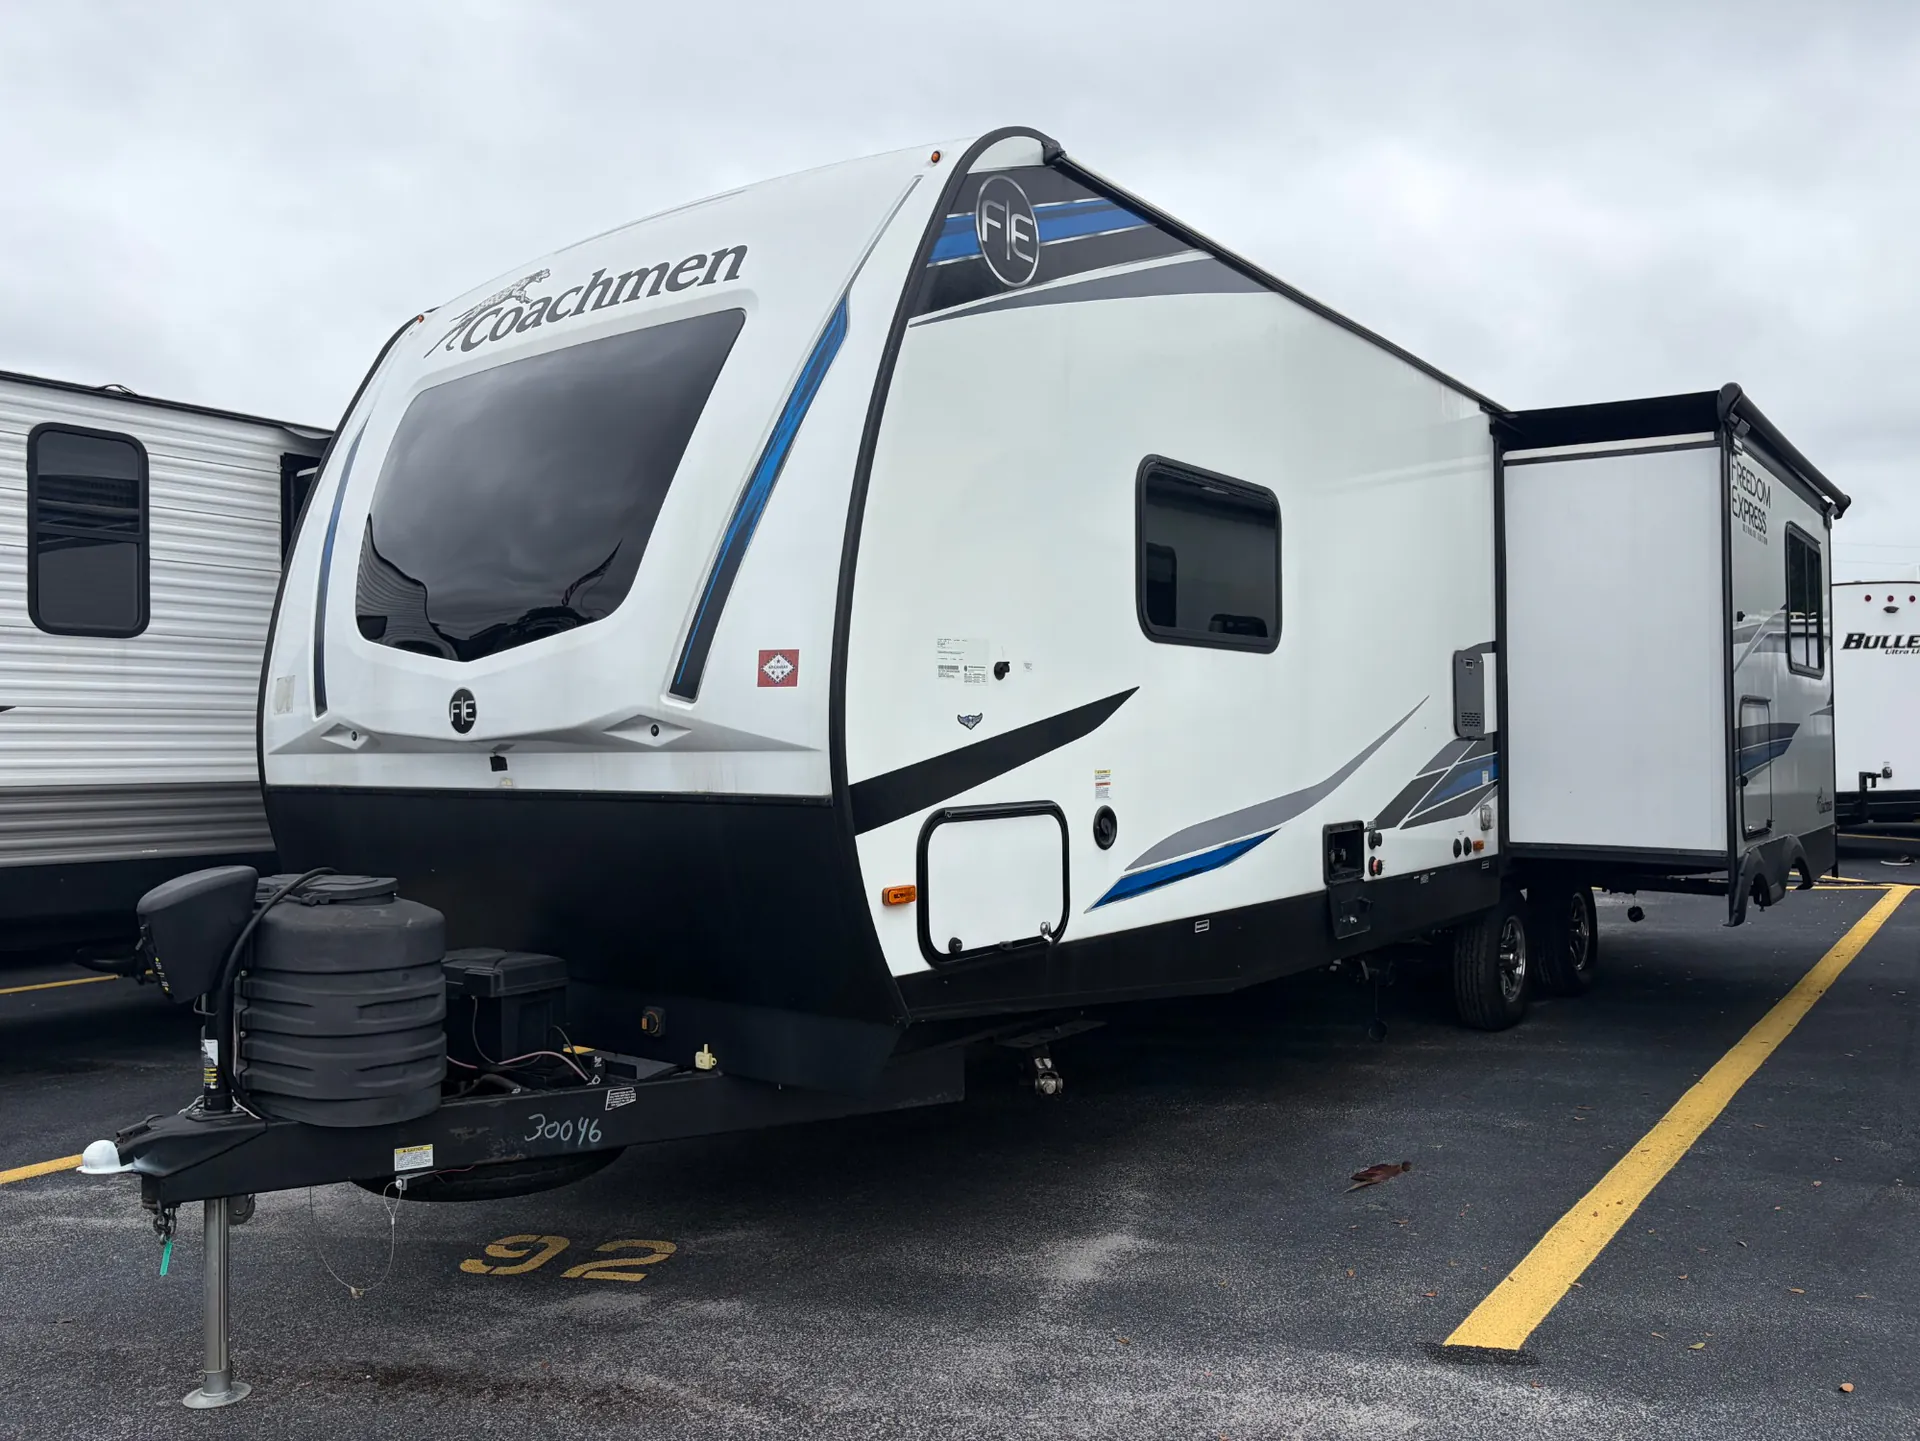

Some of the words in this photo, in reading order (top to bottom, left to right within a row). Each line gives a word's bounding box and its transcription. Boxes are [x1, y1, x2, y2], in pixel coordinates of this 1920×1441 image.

[460, 244, 748, 352] Coachmen
[1731, 455, 1771, 509] FREEDOM
[1731, 484, 1767, 535] EXPRESS
[523, 1113, 602, 1146] 30046
[459, 1234, 678, 1282] 92
